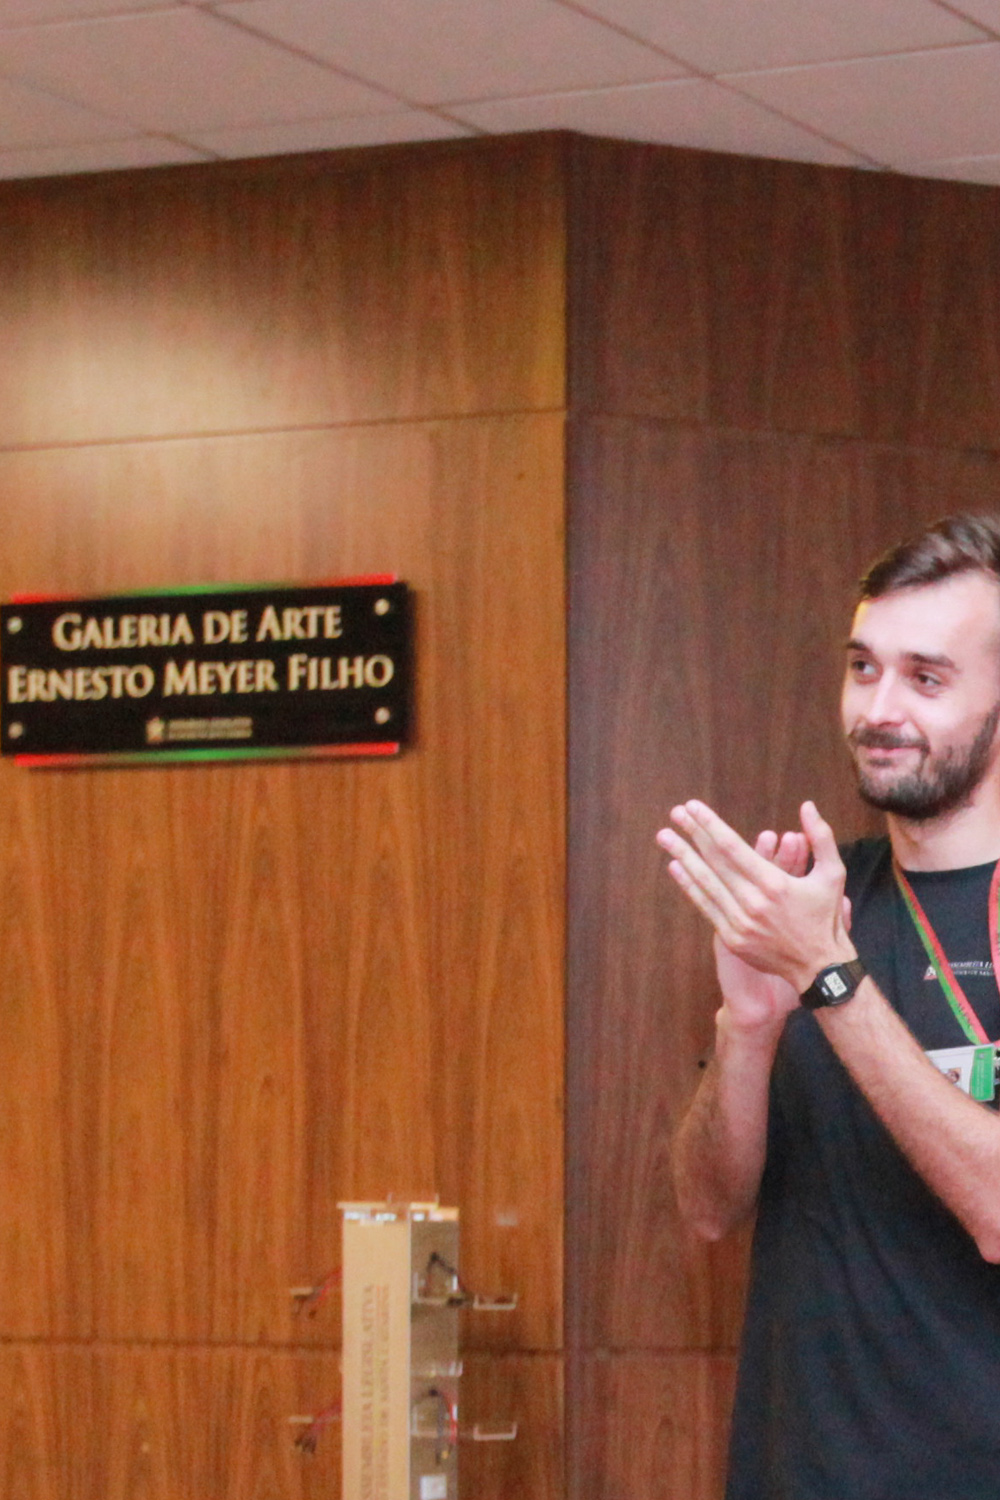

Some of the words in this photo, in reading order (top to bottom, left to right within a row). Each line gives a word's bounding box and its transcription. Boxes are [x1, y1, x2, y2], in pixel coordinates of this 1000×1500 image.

[52, 612, 195, 651] GALERIA
[203, 610, 248, 644] DE
[256, 605, 343, 642] ARTE
[8, 664, 155, 703] ERNESTO
[163, 659, 279, 697] MEYER
[288, 653, 395, 691] FILHO
